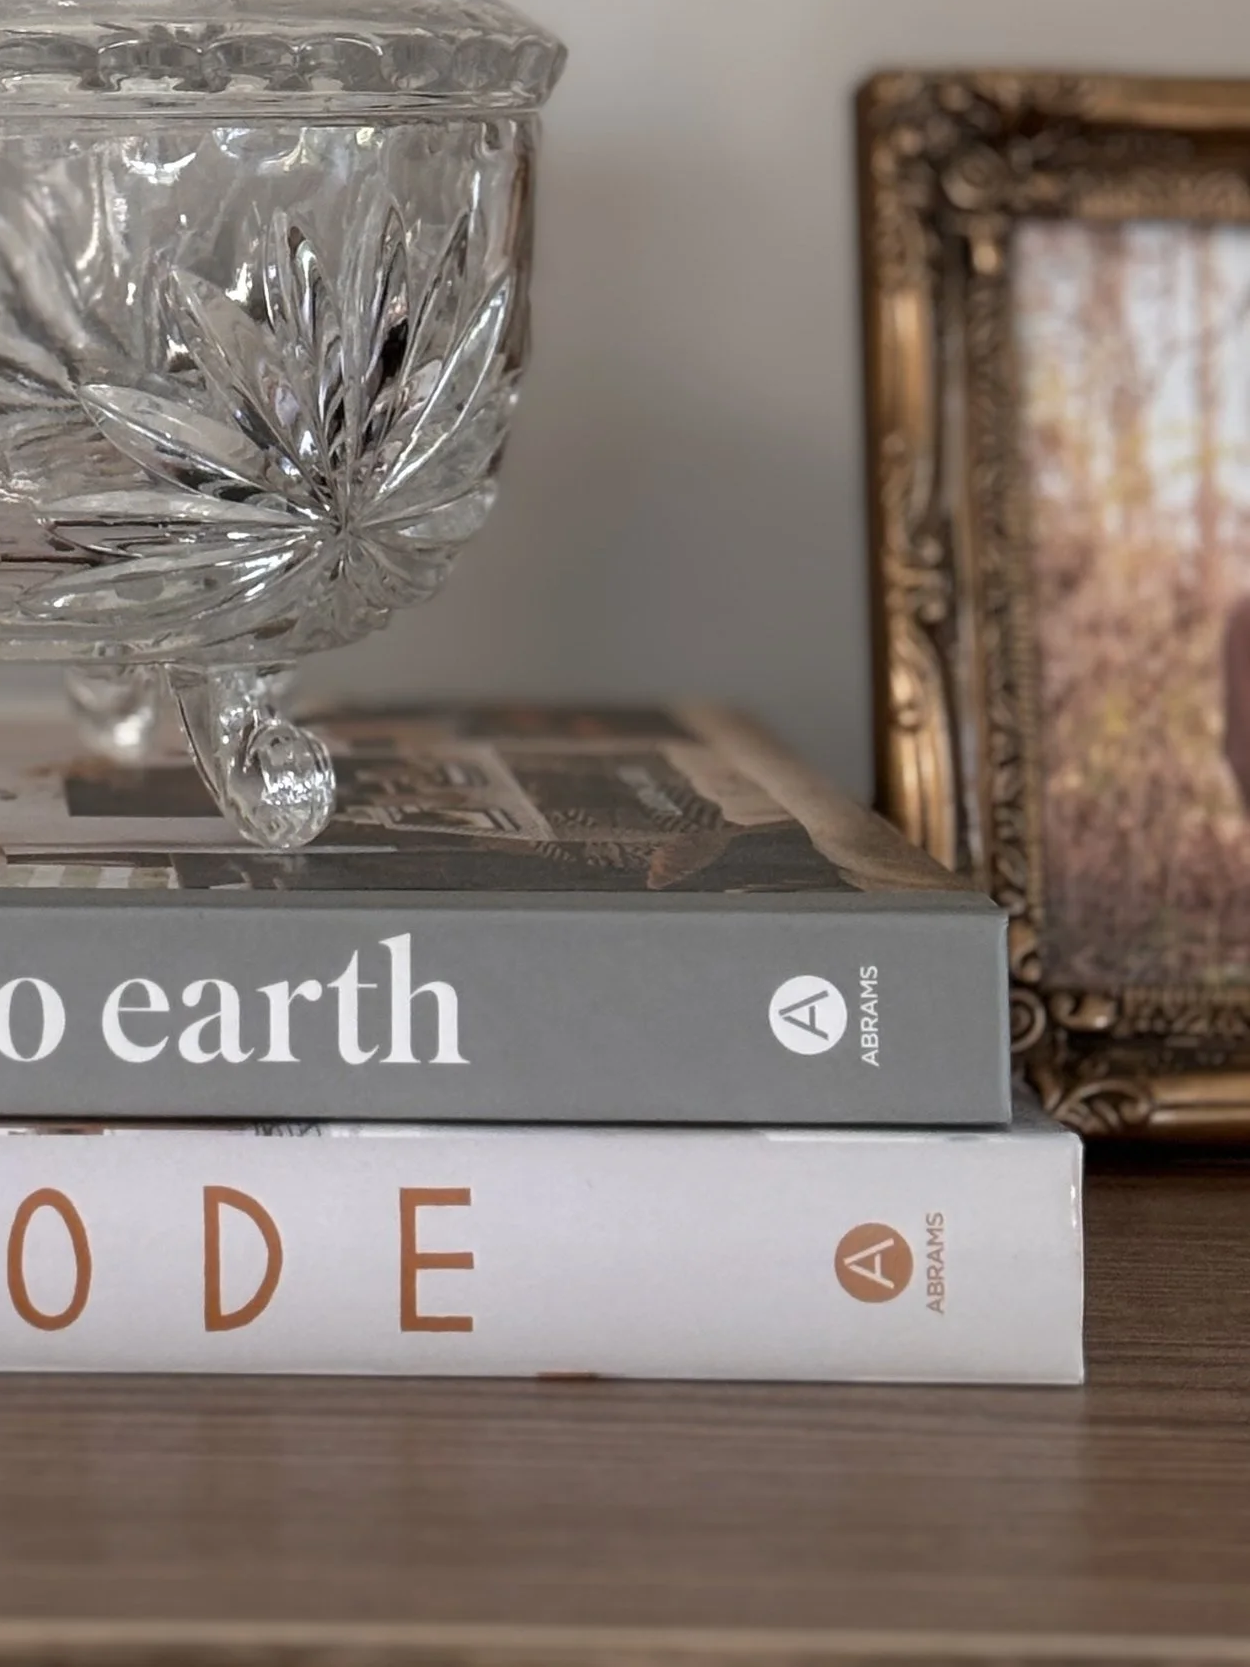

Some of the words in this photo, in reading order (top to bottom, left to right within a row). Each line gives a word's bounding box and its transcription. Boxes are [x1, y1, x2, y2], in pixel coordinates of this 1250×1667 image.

[101, 932, 471, 1066] earth
[860, 965, 880, 1067] ABRAMS
[926, 1212, 945, 1314] ABRAMS
